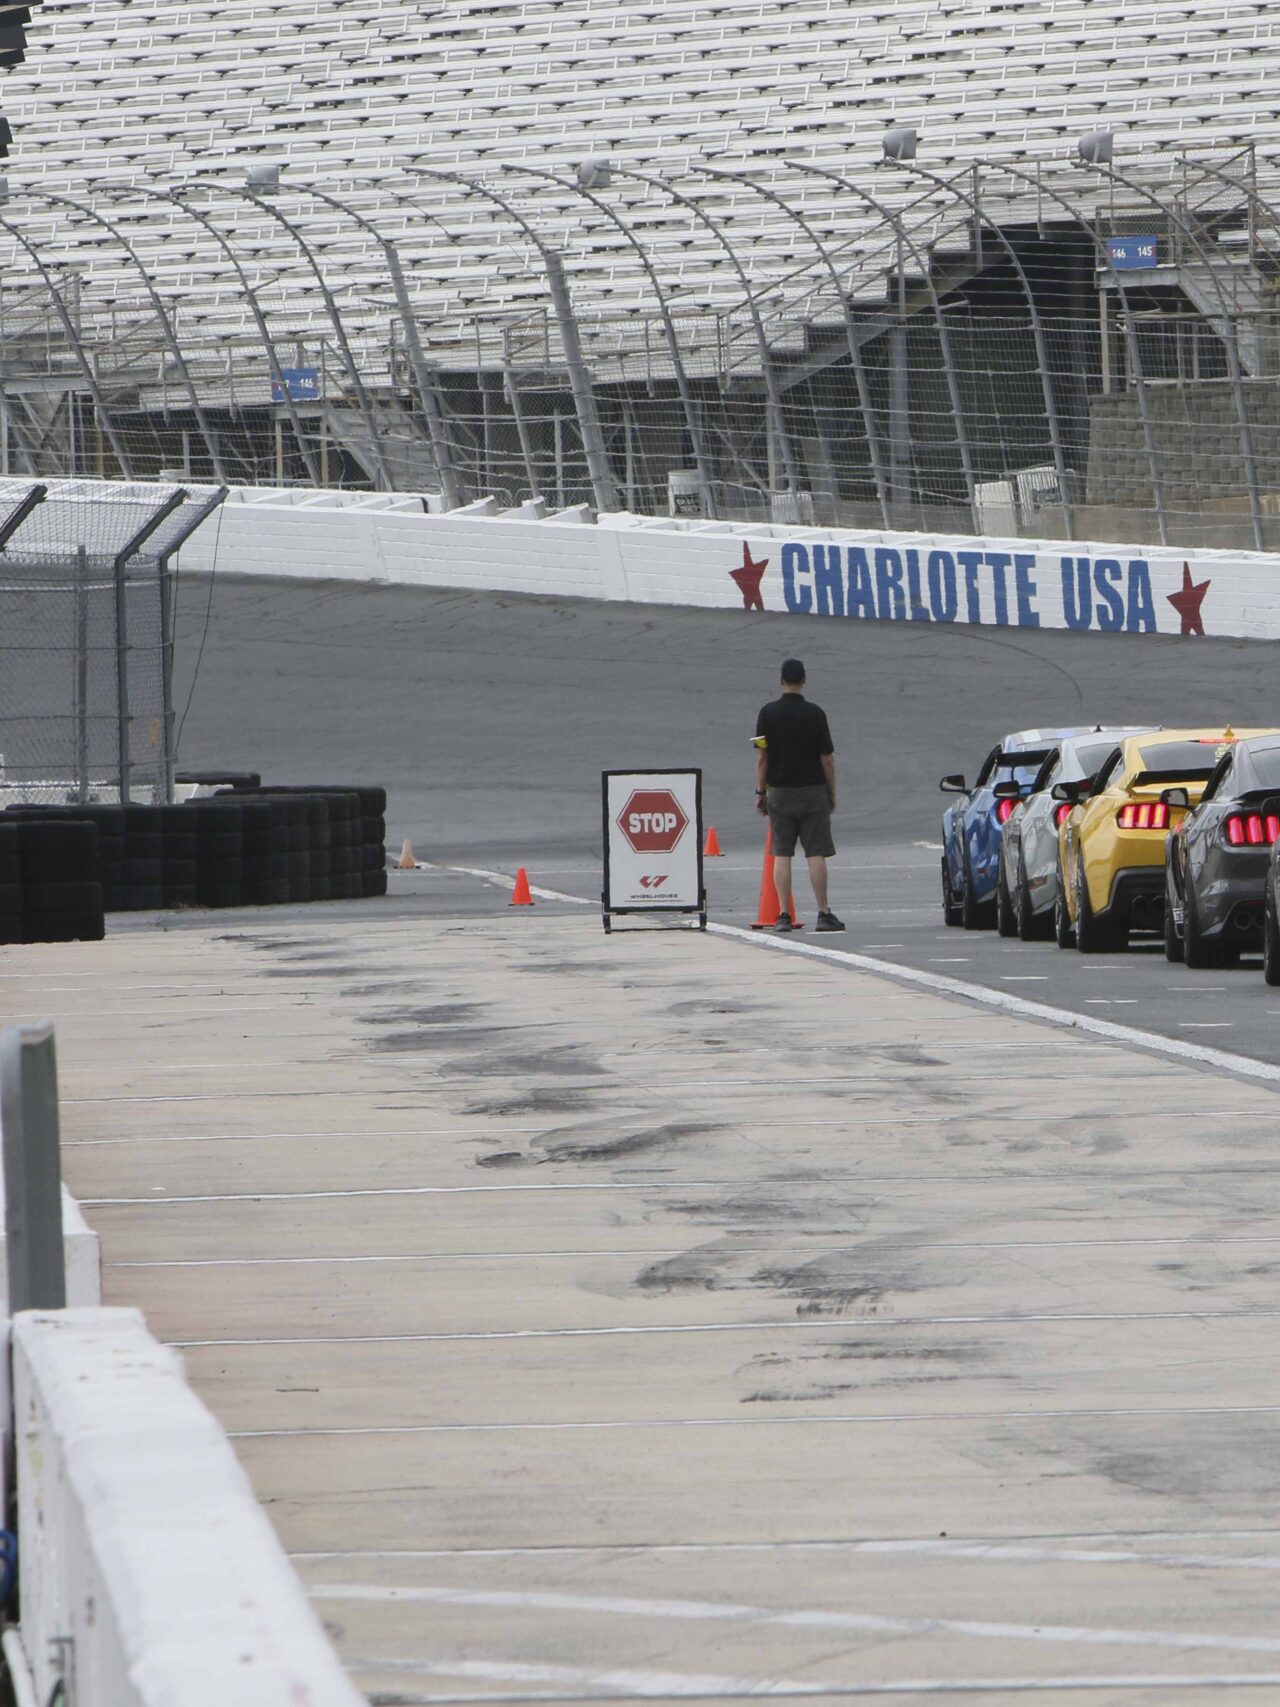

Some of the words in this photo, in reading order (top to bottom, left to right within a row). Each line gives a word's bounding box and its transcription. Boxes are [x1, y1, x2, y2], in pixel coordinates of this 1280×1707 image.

[1137, 246, 1152, 257] 145
[781, 543, 1040, 628] CHARLOTTE
[1061, 557, 1157, 633] USA
[629, 812, 677, 834] STOP
